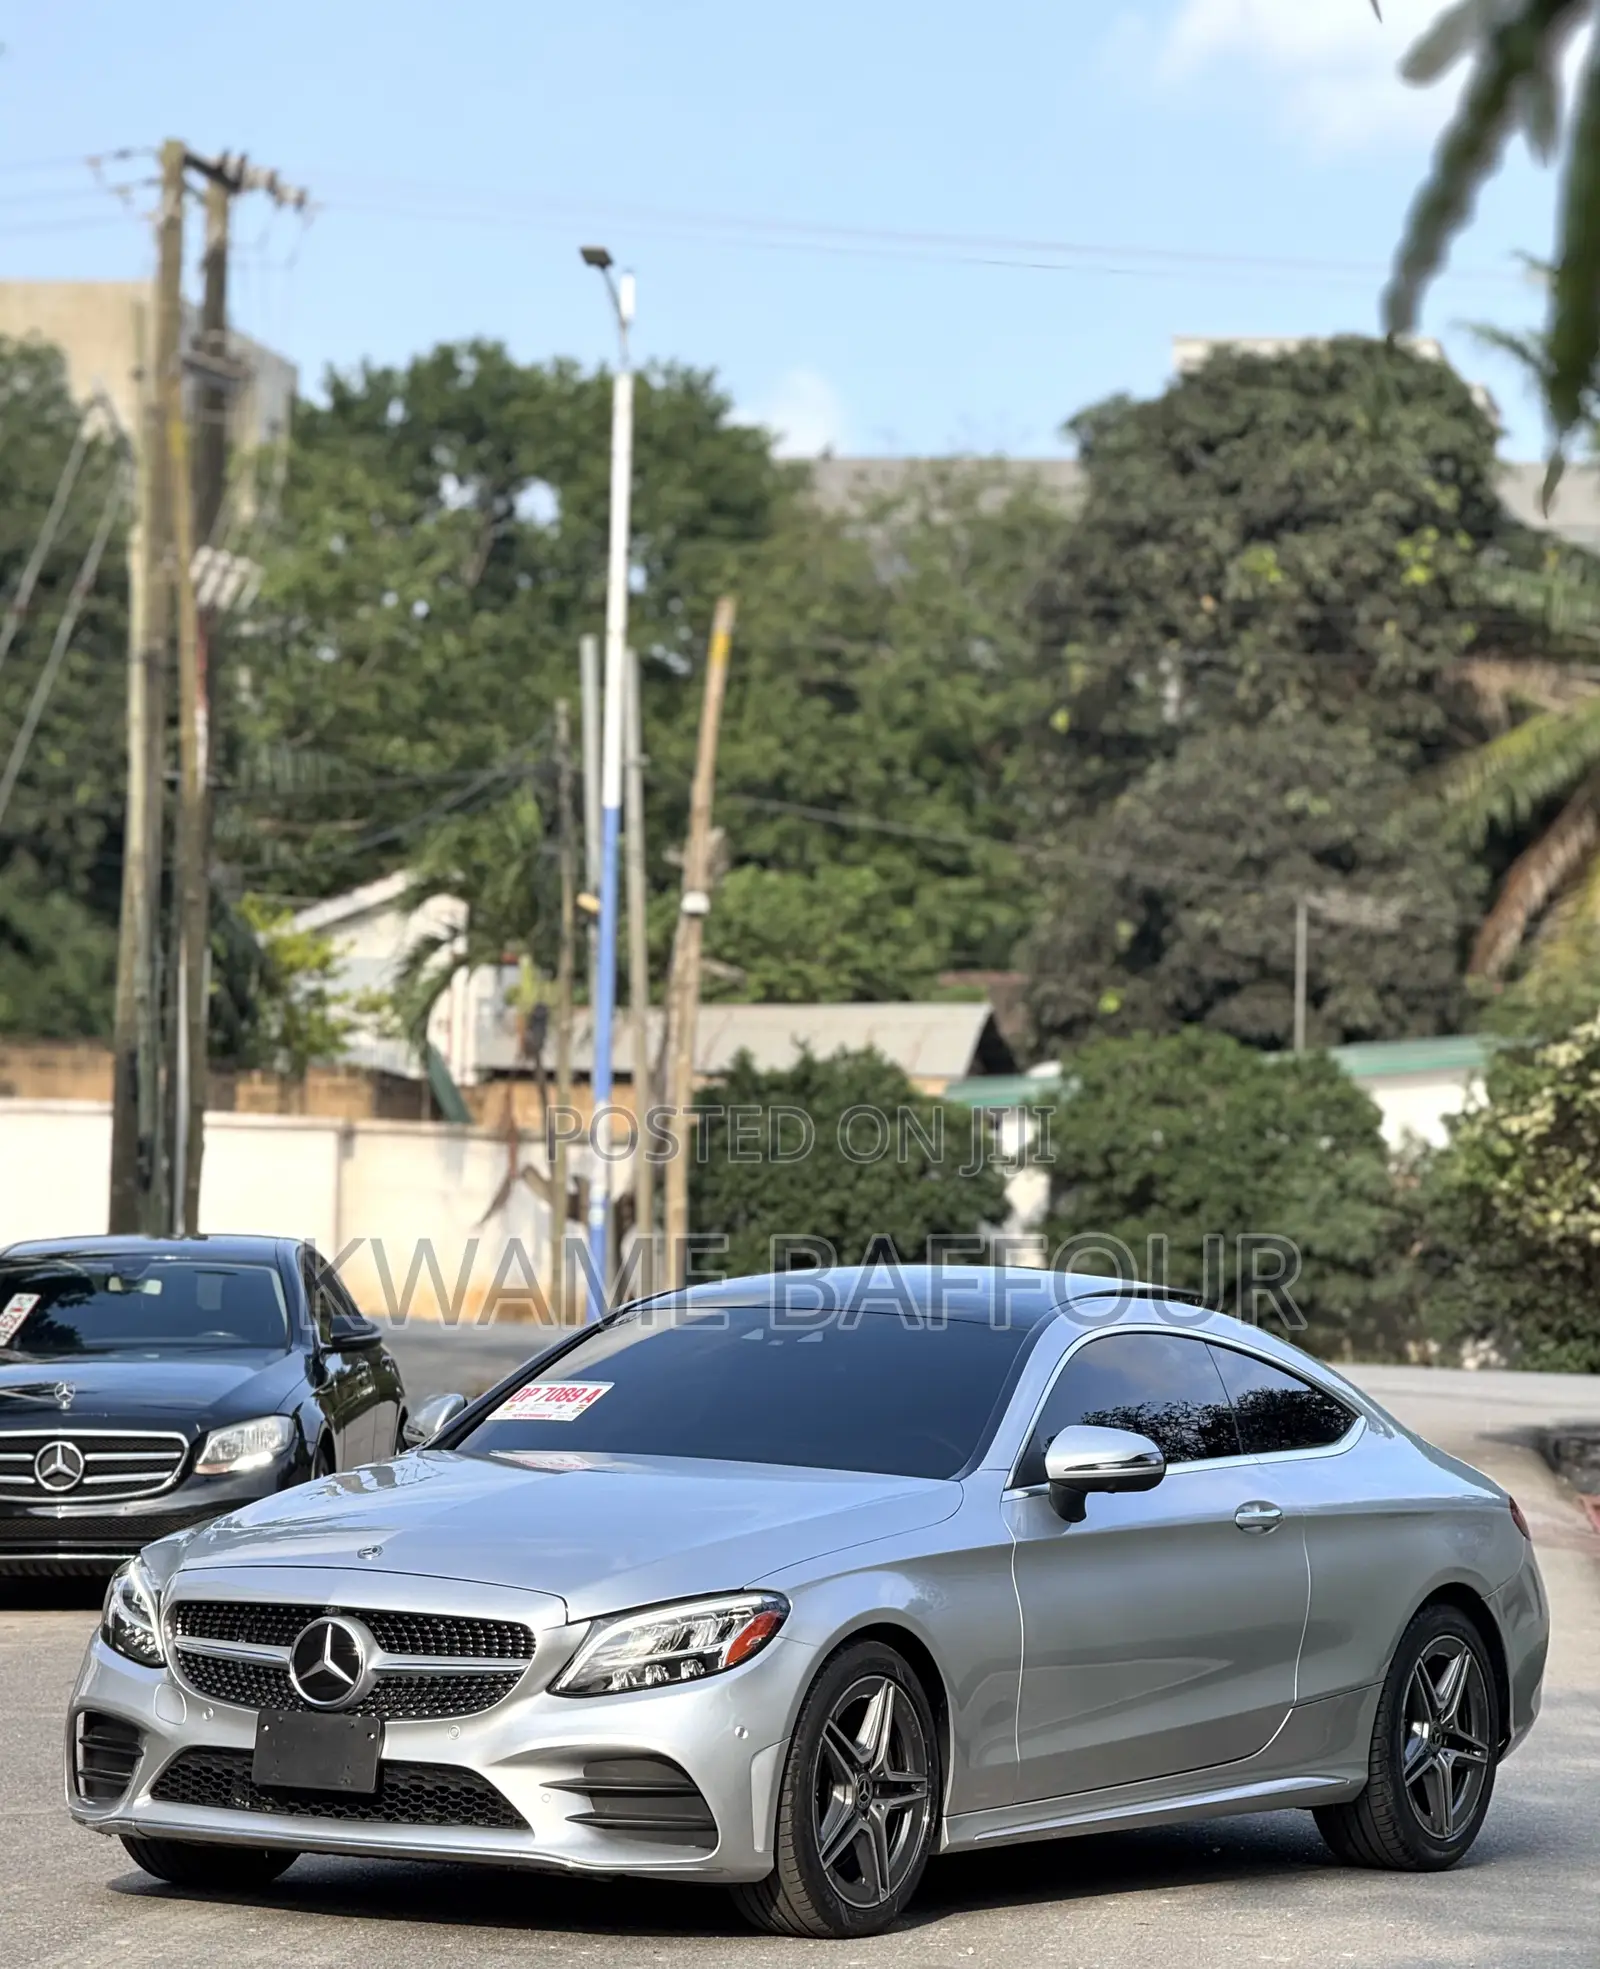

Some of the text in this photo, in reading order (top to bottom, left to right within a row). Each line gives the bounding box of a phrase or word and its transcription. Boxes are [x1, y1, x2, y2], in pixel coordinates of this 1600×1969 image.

[509, 1387, 603, 1404] DP 7089 A
